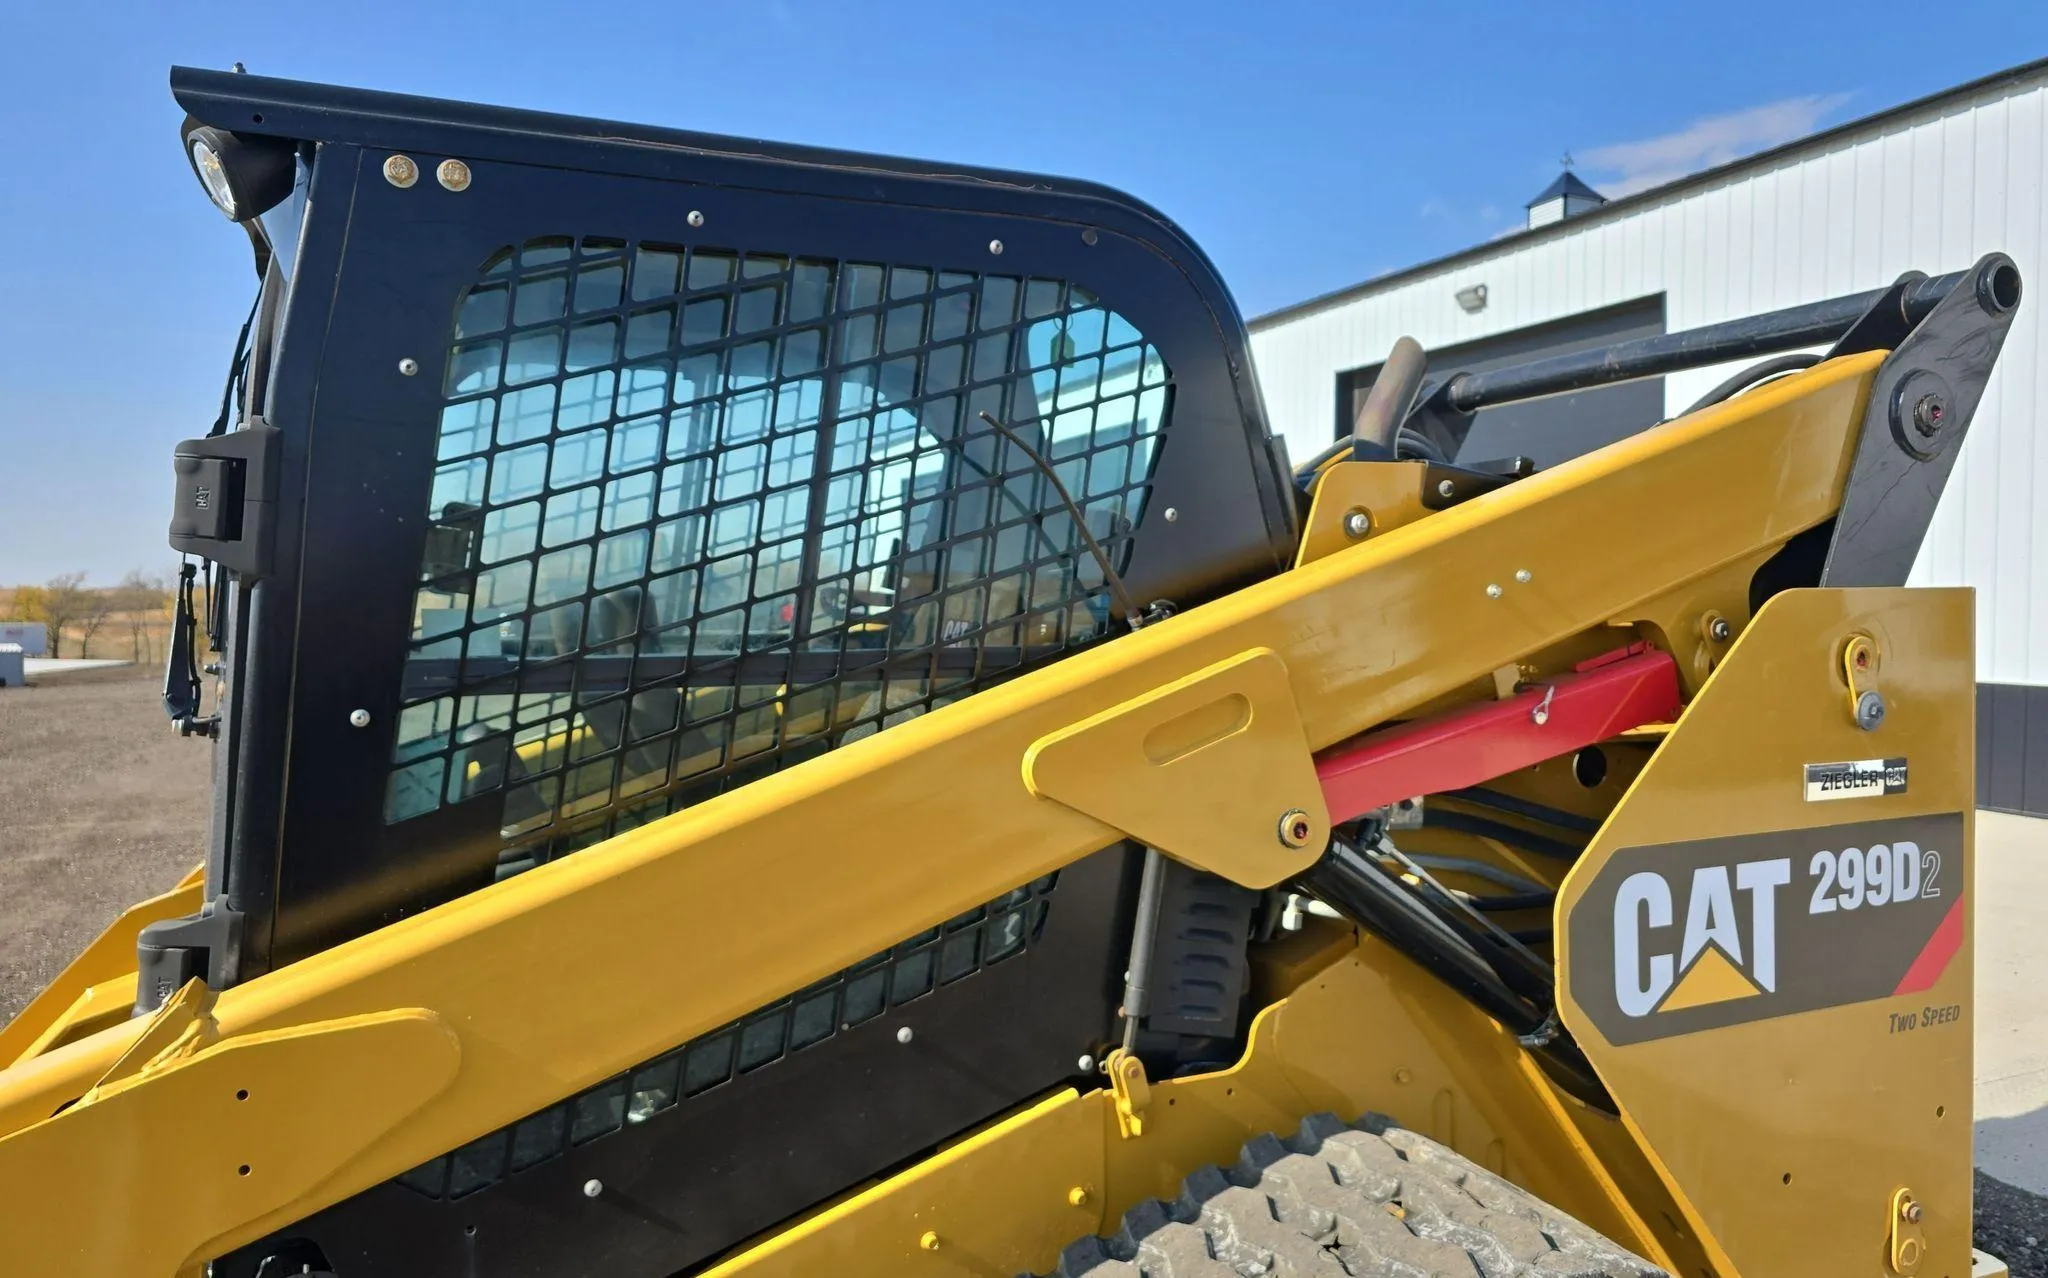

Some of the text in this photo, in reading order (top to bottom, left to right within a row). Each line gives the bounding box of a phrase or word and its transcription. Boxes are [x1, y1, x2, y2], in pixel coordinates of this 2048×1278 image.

[1820, 766, 1907, 792] ZIEGLER CAT
[1809, 841, 1941, 915] 299D2
[1614, 858, 1791, 1018] CAT
